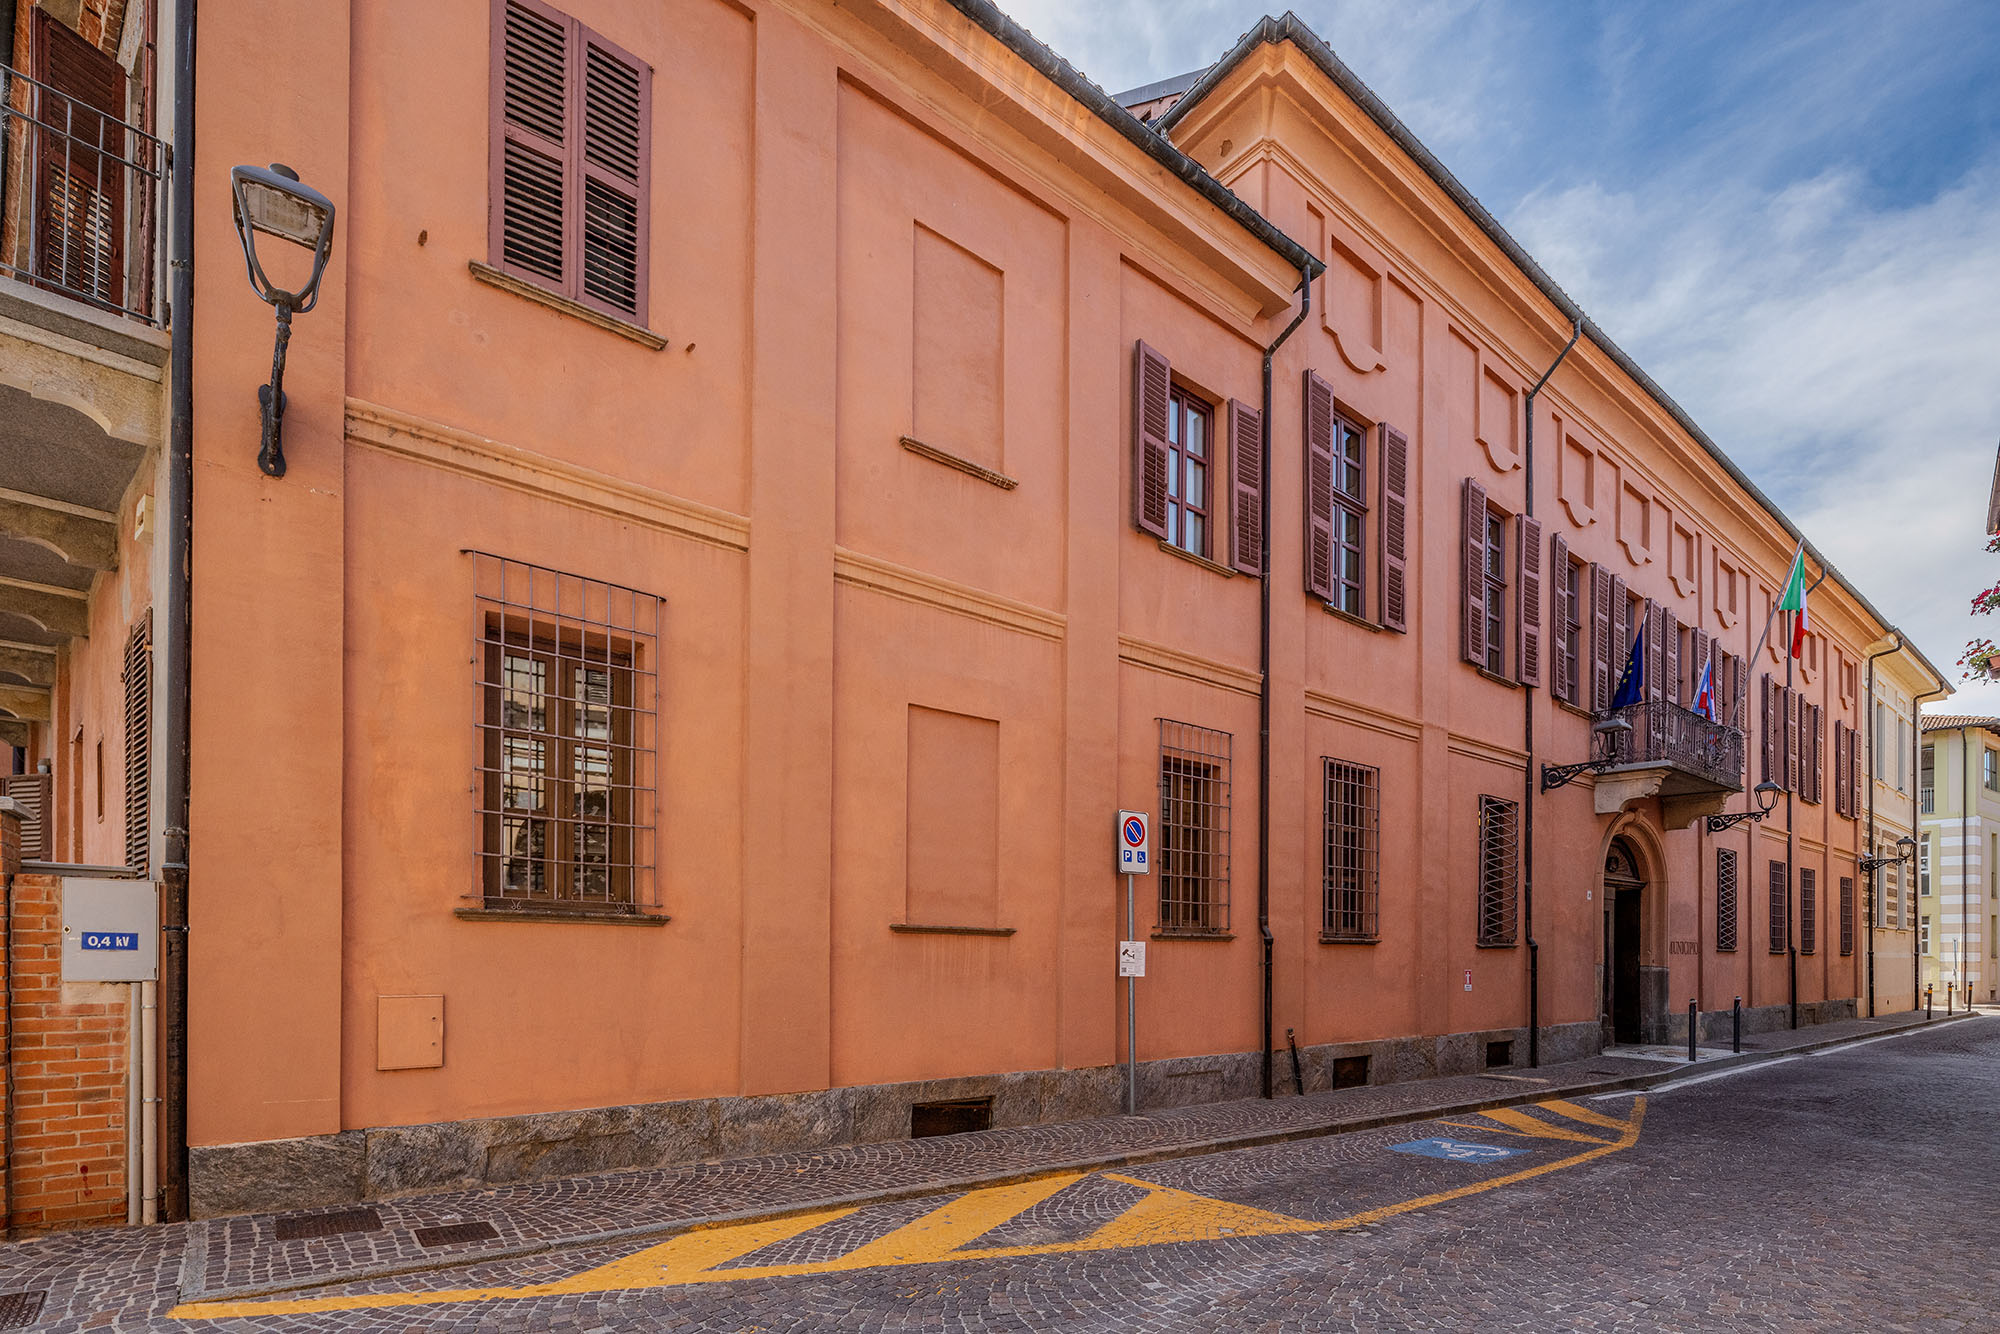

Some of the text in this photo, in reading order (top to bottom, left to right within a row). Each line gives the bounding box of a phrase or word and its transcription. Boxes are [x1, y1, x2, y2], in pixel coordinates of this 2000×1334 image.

[1124, 851, 1131, 861] P
[87, 935, 130, 948] 0,4 kV
